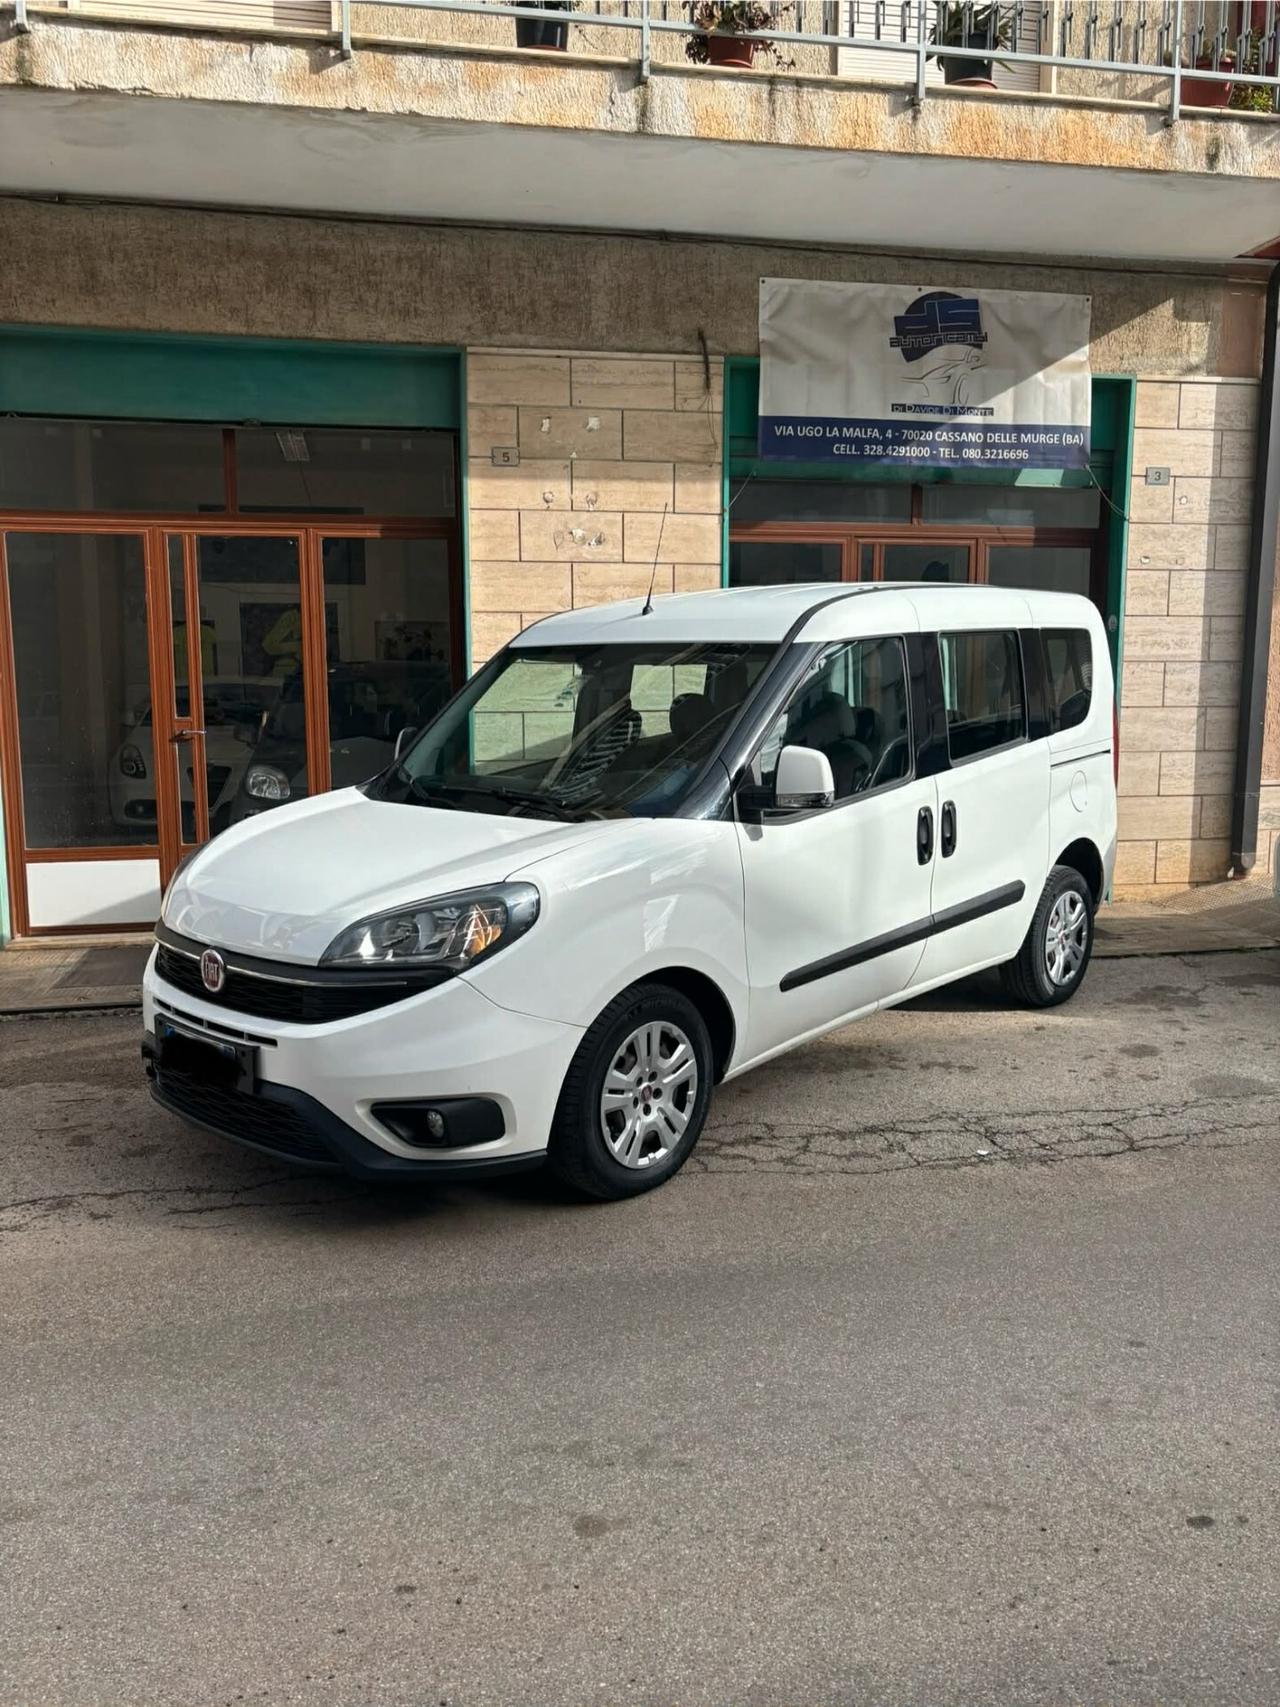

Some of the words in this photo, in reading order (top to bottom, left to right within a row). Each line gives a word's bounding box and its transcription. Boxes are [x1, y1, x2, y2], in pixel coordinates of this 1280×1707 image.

[774, 425, 794, 436] VIA
[797, 426, 823, 437] UGO
[826, 427, 840, 438] LA
[842, 427, 883, 440] MALFA,
[885, 429, 892, 439] 4
[901, 429, 933, 441] 70020
[935, 431, 984, 443] CASSANO
[986, 432, 1018, 443] DELLE
[1020, 433, 1060, 445] MURGE
[1062, 433, 1084, 446] (BA)
[502, 452, 510, 463] 5
[833, 444, 860, 454] CELL.
[863, 445, 930, 457] 328.4291000
[939, 447, 960, 458] TEL.
[962, 449, 1029, 460] 080.3216696
[1154, 471, 1162, 481] 3
